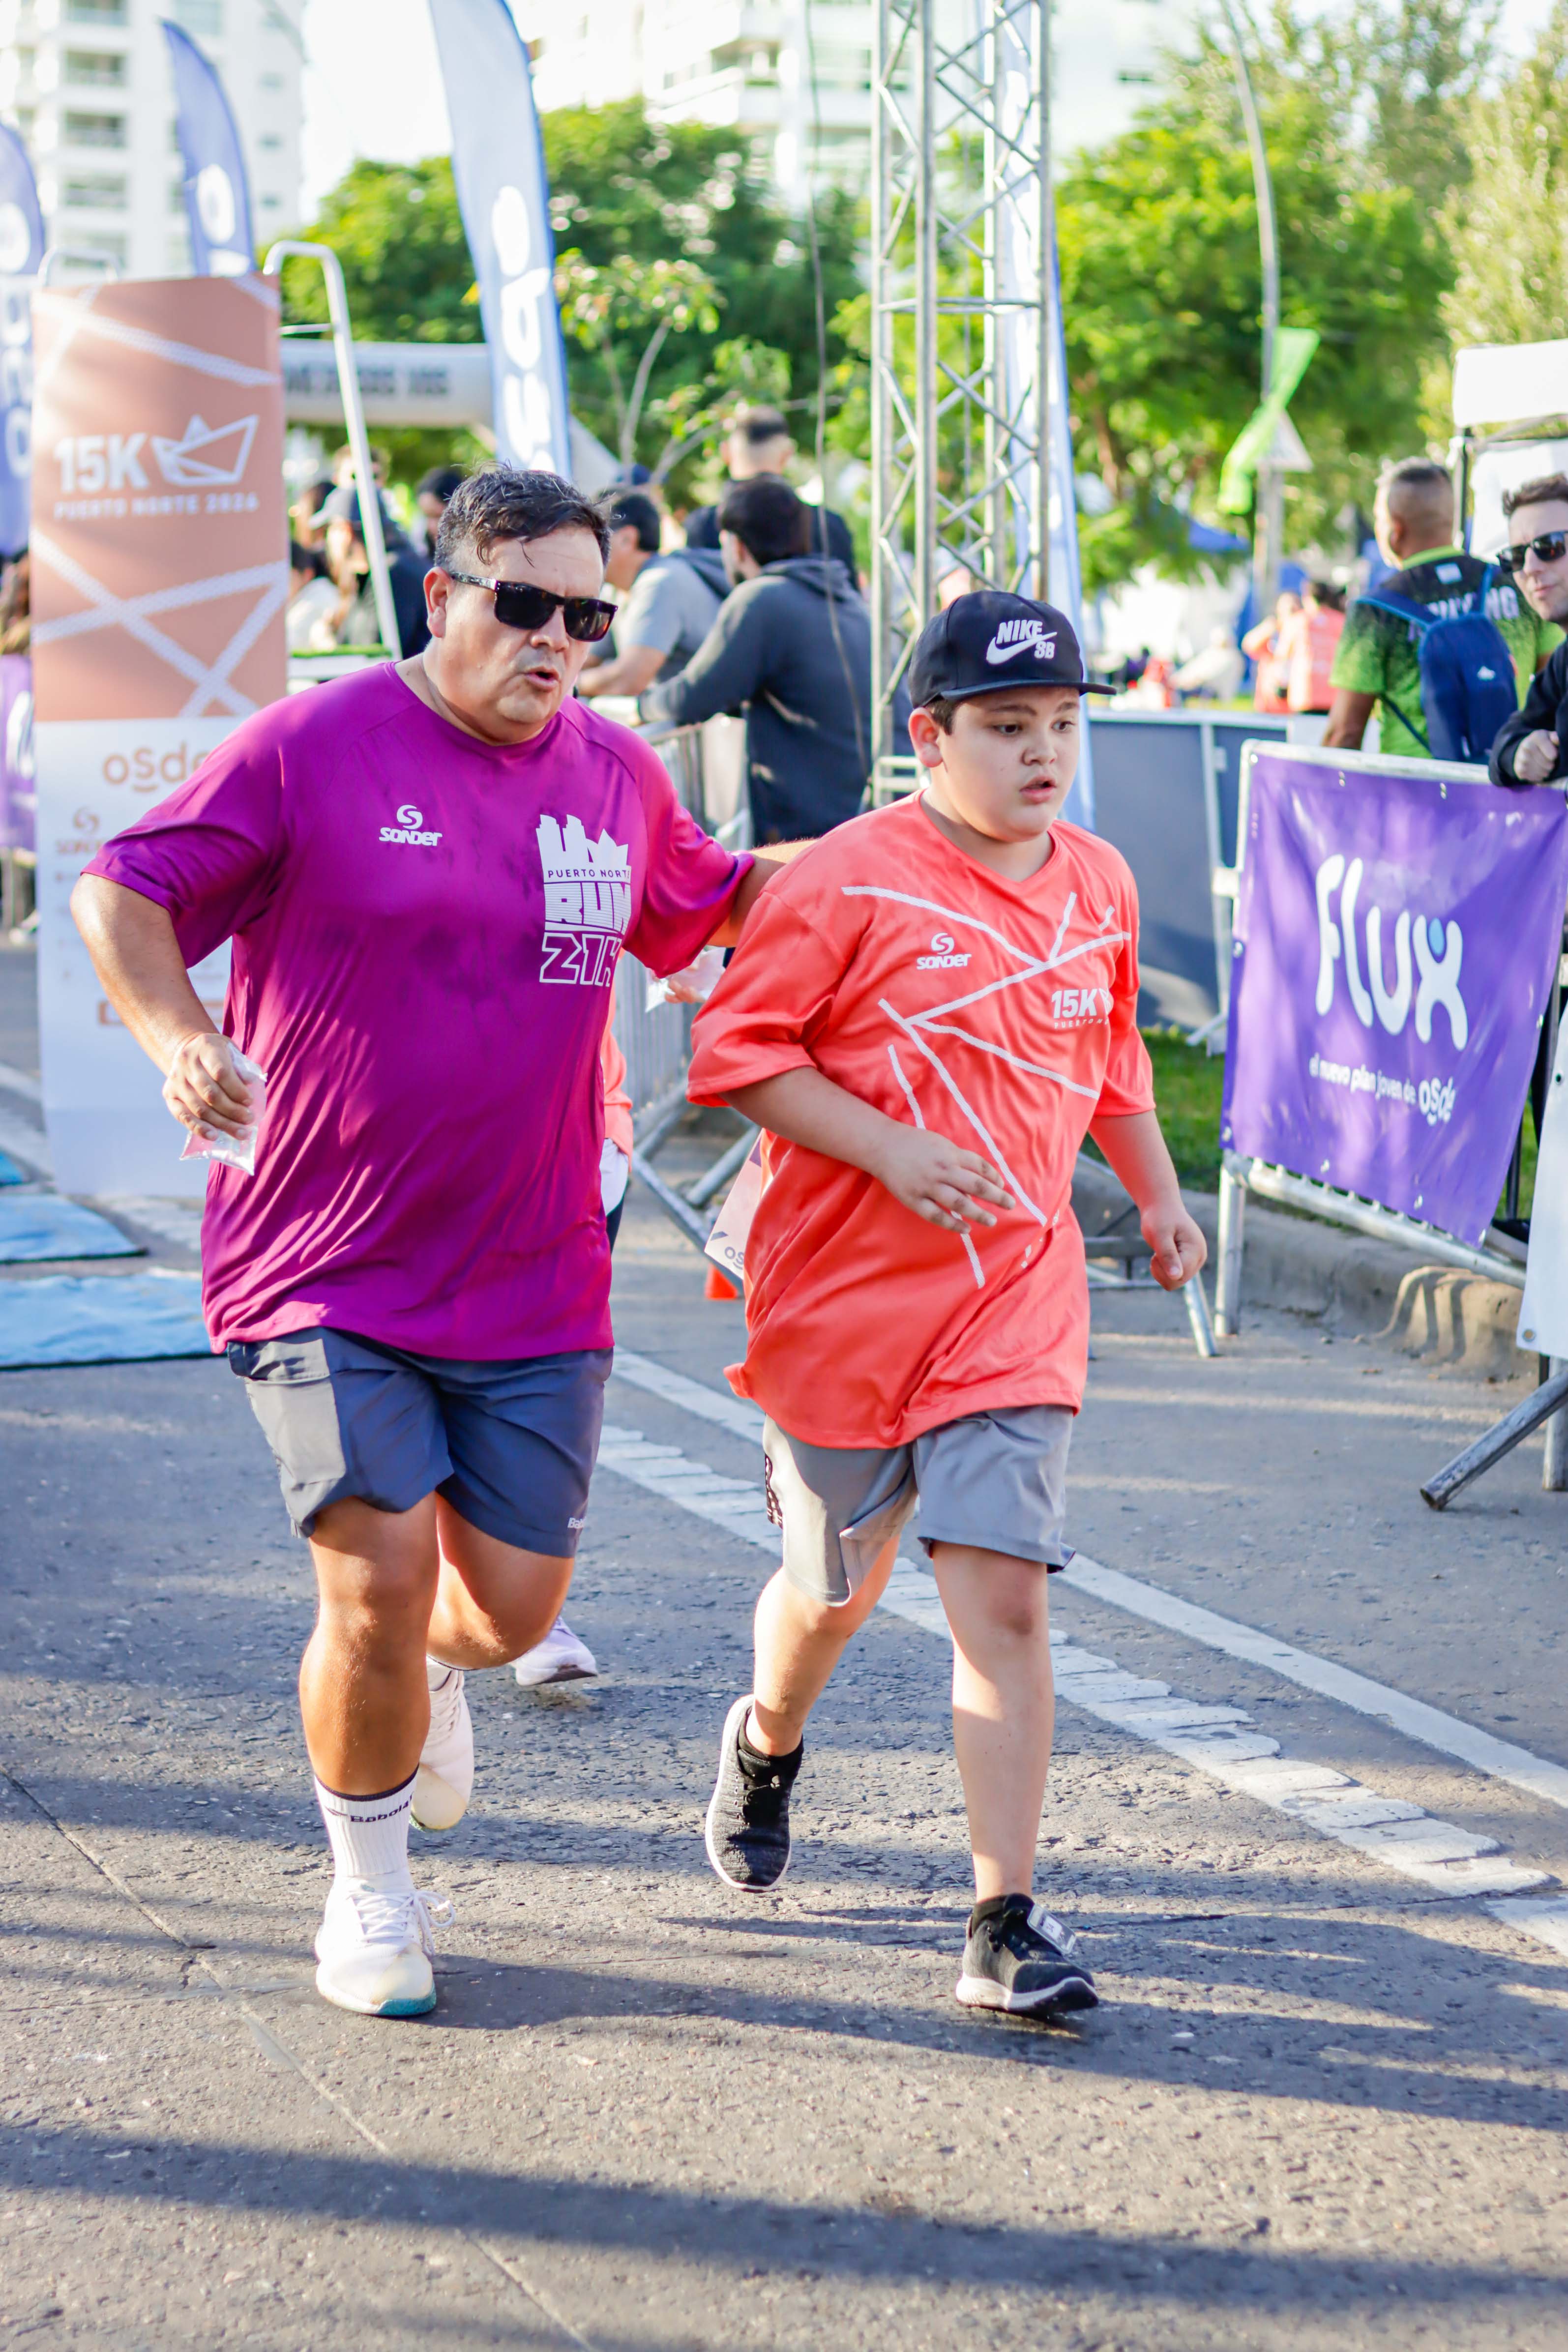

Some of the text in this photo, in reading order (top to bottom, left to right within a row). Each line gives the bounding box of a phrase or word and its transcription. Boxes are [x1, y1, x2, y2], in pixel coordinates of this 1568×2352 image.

[54, 433, 149, 492] 15K
[996, 619, 1043, 644] NIKE
[1034, 641, 1055, 659] SB
[548, 869, 595, 878] PUERTO
[544, 882, 631, 935] RUN
[1051, 988, 1098, 1019] 15K
[1054, 1018, 1094, 1029] PUERTO
[1309, 1052, 1320, 1077] el
[1319, 1059, 1351, 1086] nuevo
[1350, 1064, 1376, 1094] plan
[1375, 1069, 1402, 1101] joven
[1403, 1078, 1417, 1105] de
